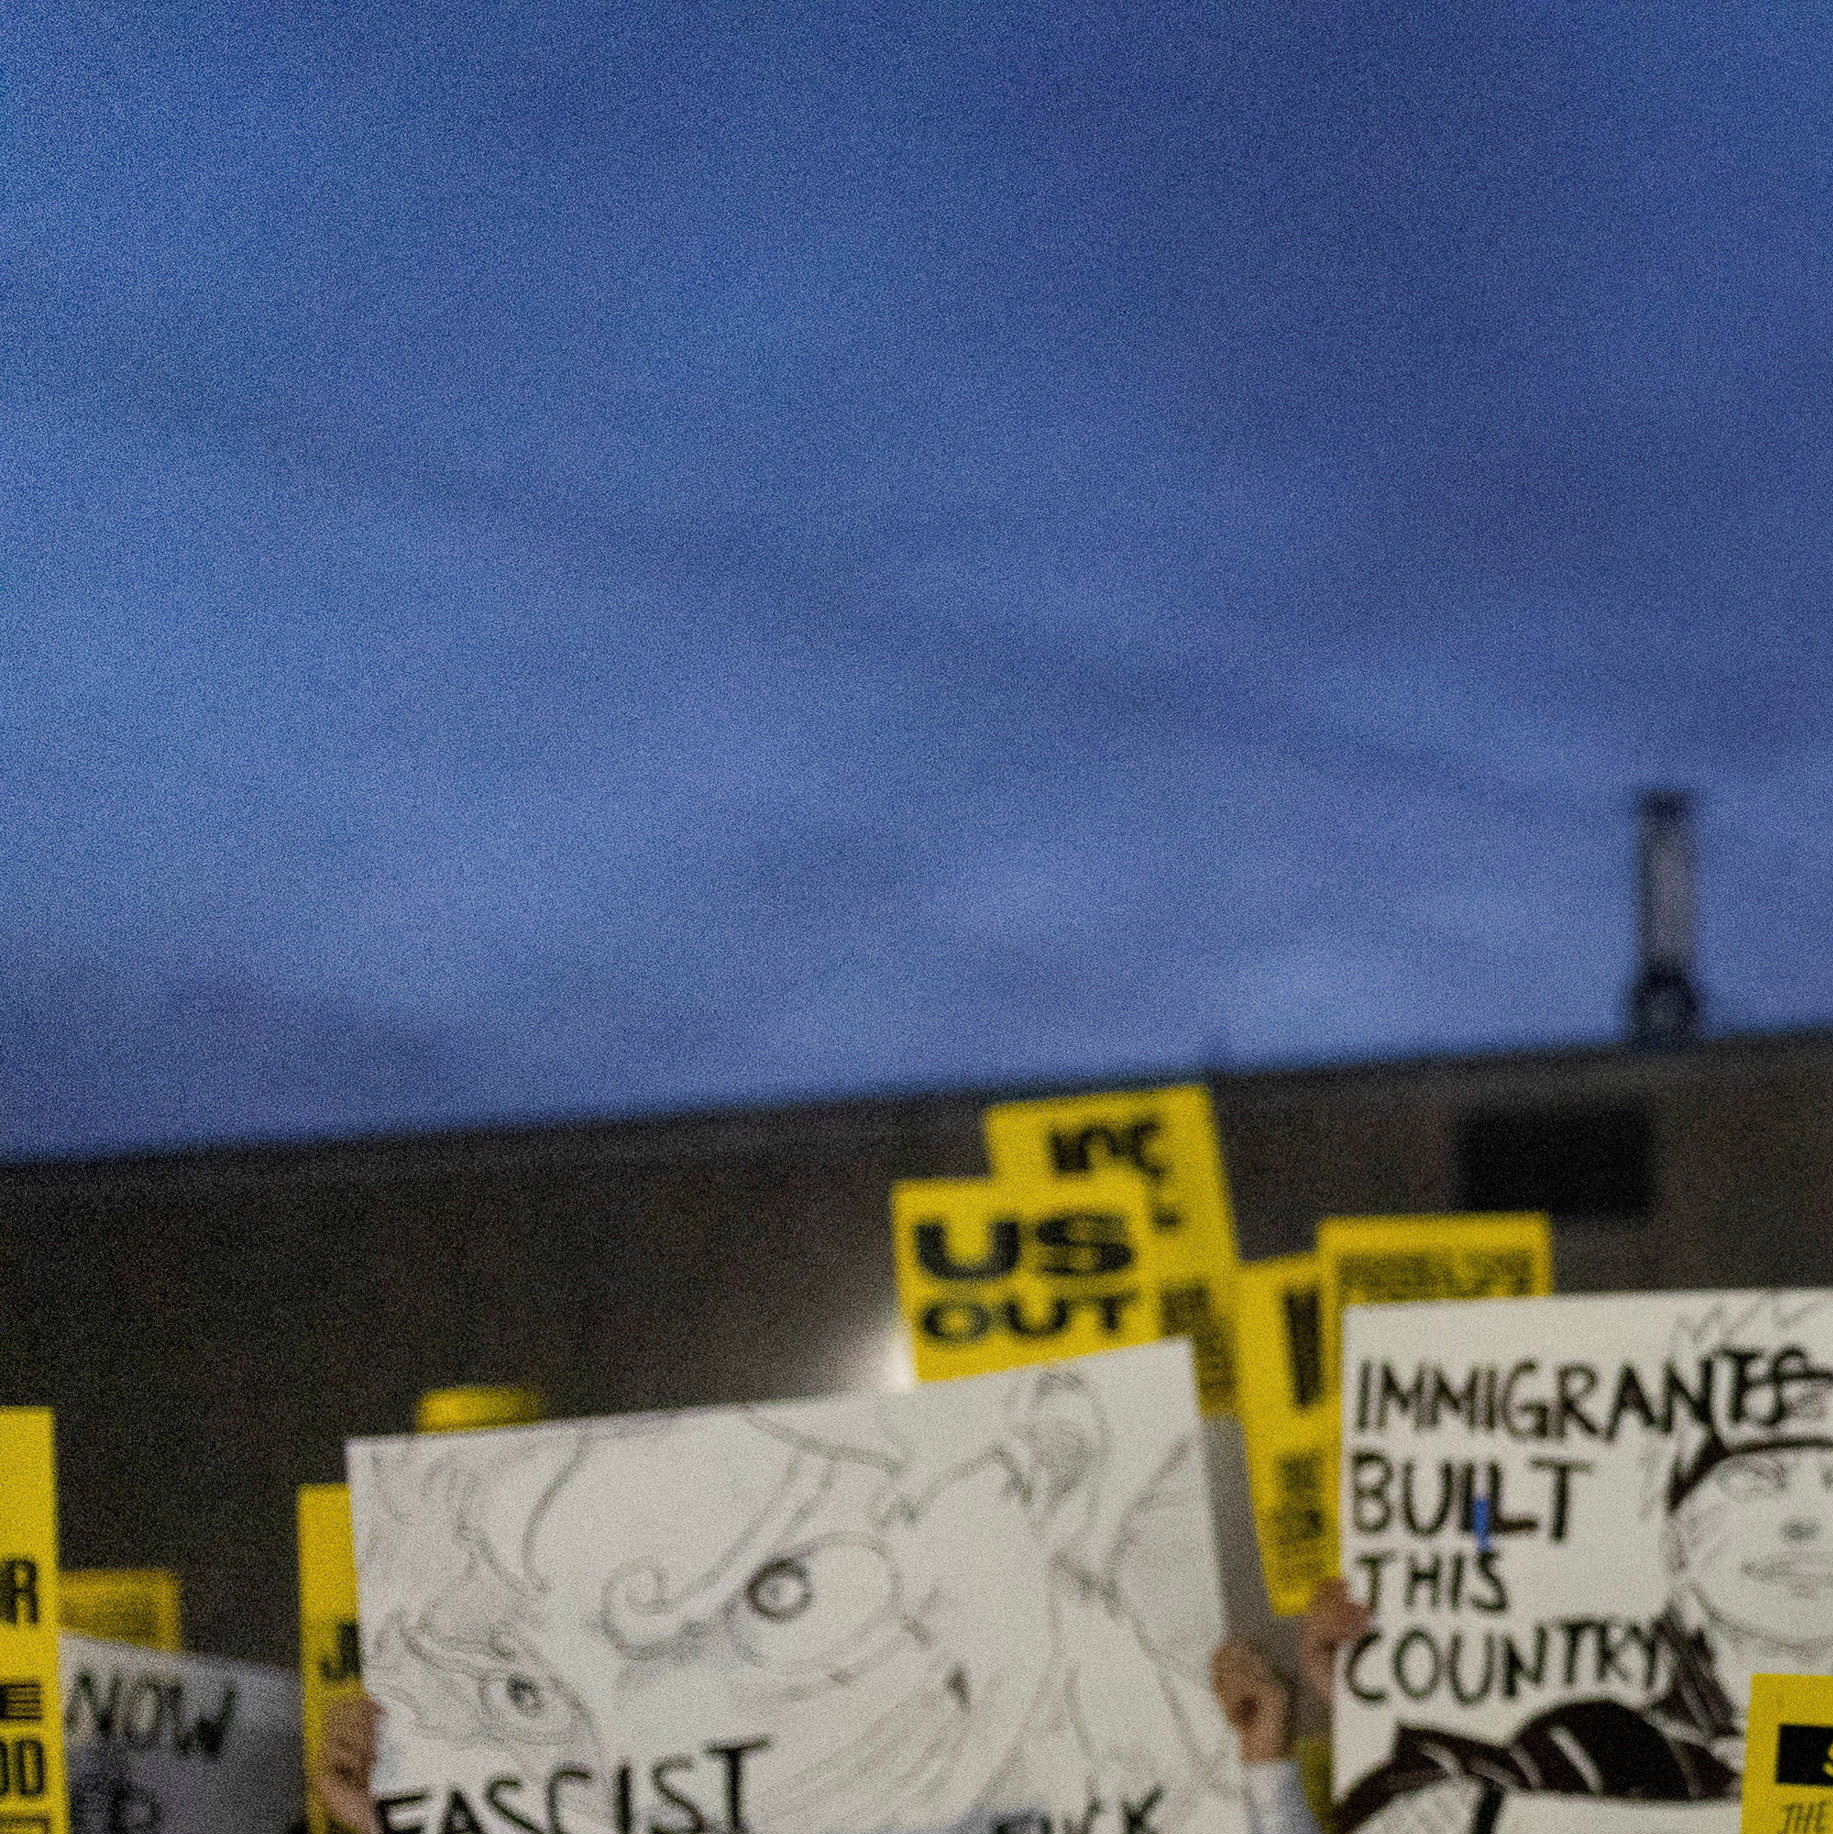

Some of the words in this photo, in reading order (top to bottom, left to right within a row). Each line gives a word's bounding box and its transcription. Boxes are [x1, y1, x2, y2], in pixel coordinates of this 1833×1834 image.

[919, 1292, 1138, 1346] OUT
[1352, 1451, 1593, 1541] BUILT
[1354, 1548, 1511, 1615] THIS
[1345, 1616, 1676, 1705] COUNTRY
